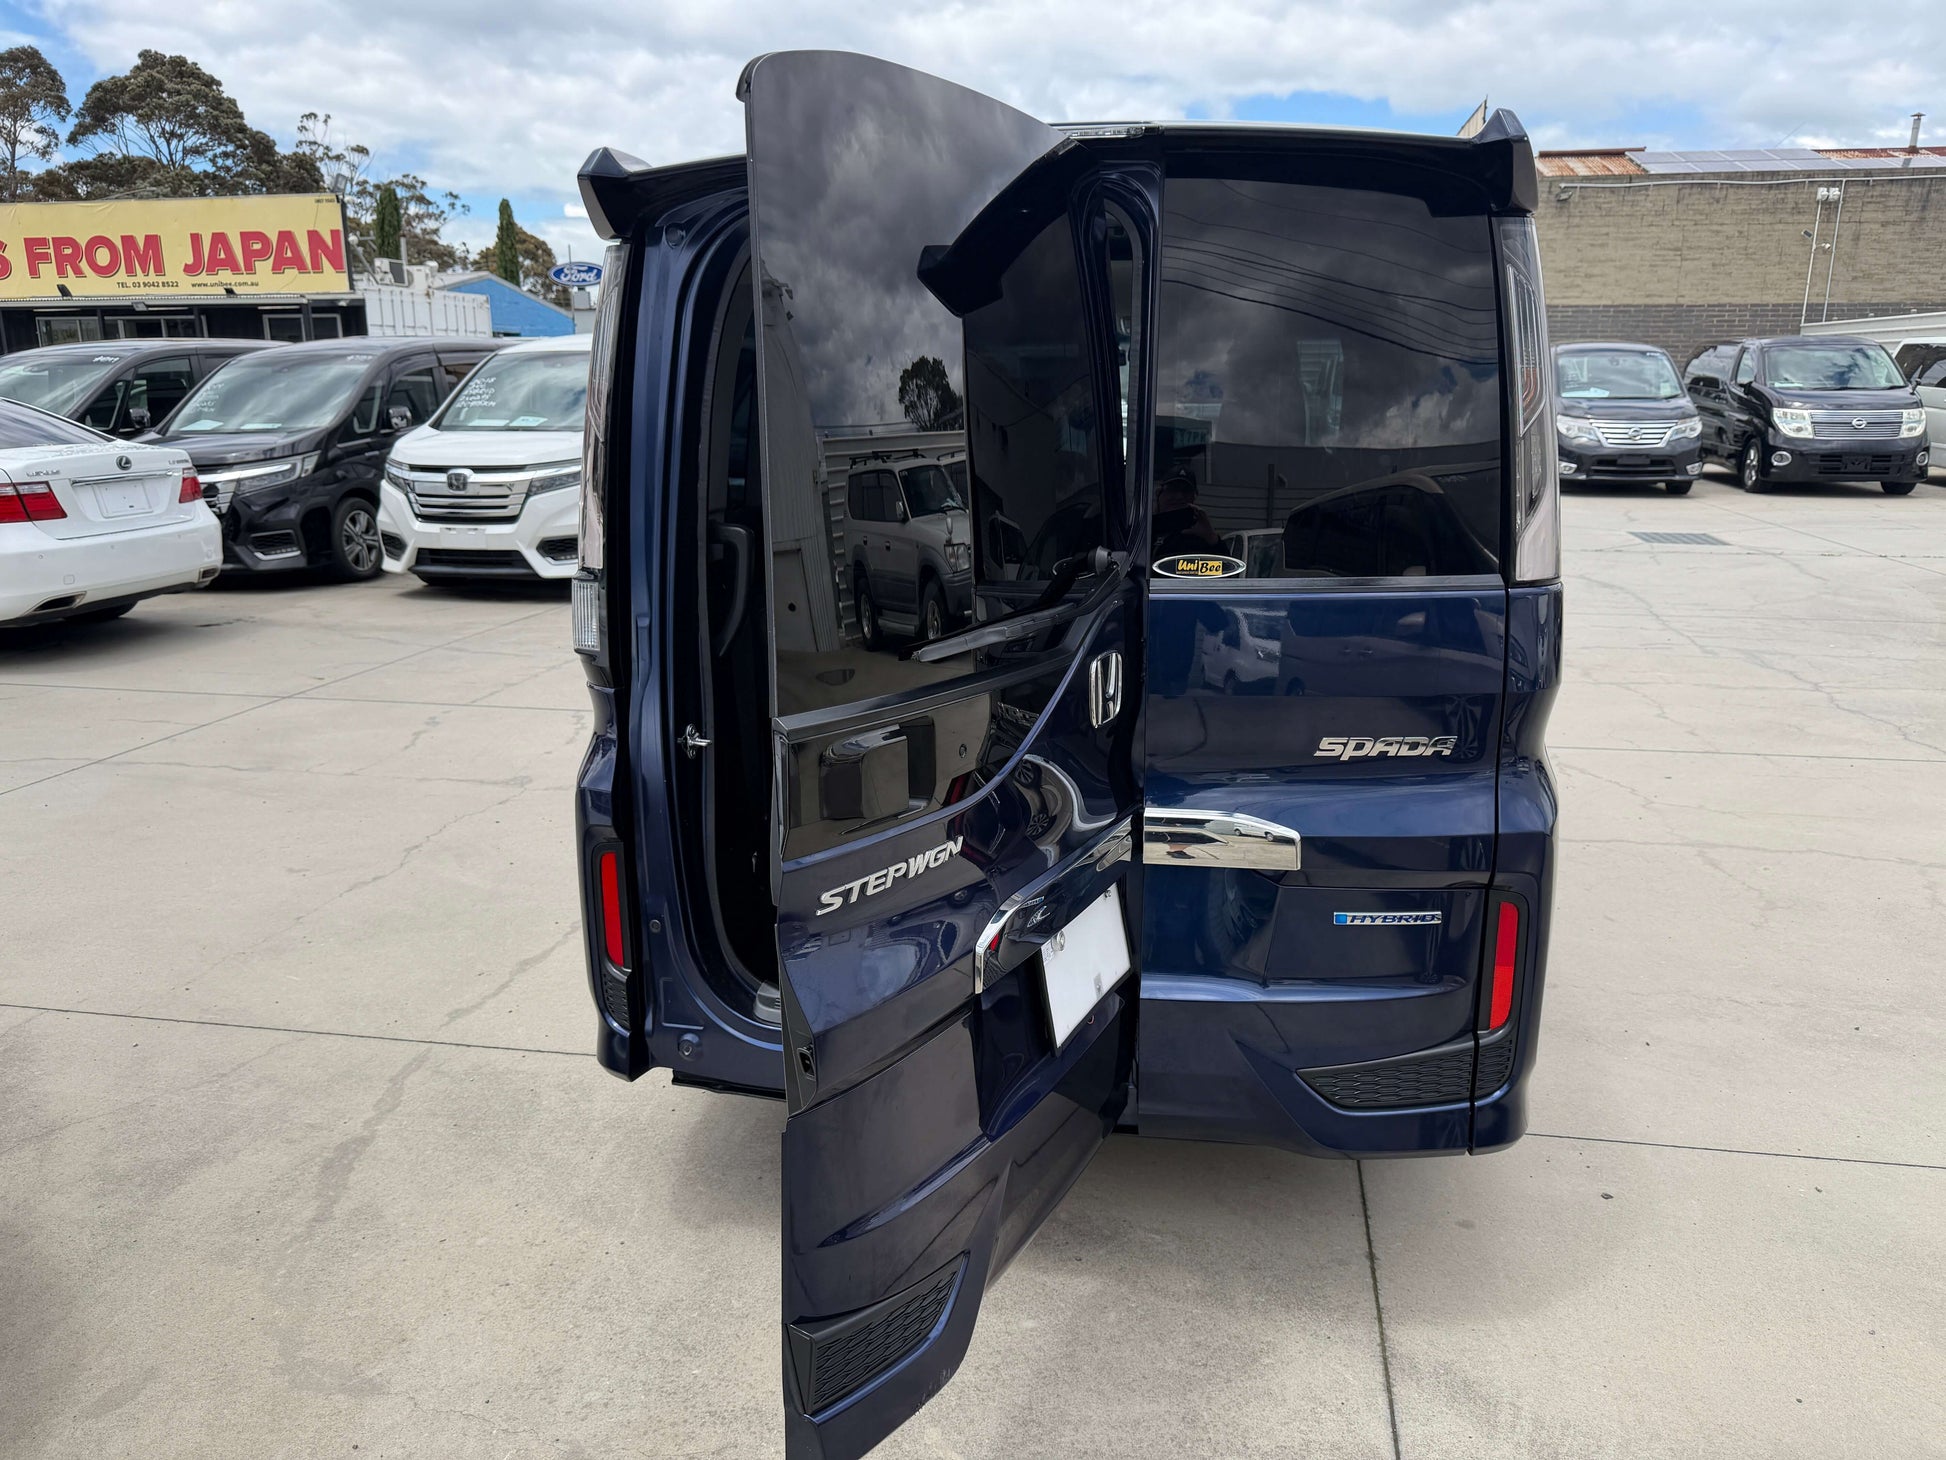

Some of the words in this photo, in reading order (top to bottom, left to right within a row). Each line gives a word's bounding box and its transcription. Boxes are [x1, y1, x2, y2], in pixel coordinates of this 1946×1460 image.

[23, 234, 165, 279] FROM
[183, 229, 346, 275] JAPAN
[560, 265, 597, 282] Ford
[117, 281, 131, 289] TEL.
[191, 280, 259, 288] www.unibee.com.au
[1314, 736, 1458, 761] SPADA
[816, 835, 964, 916] STEPWGN
[1350, 914, 1436, 924] HYBRID
